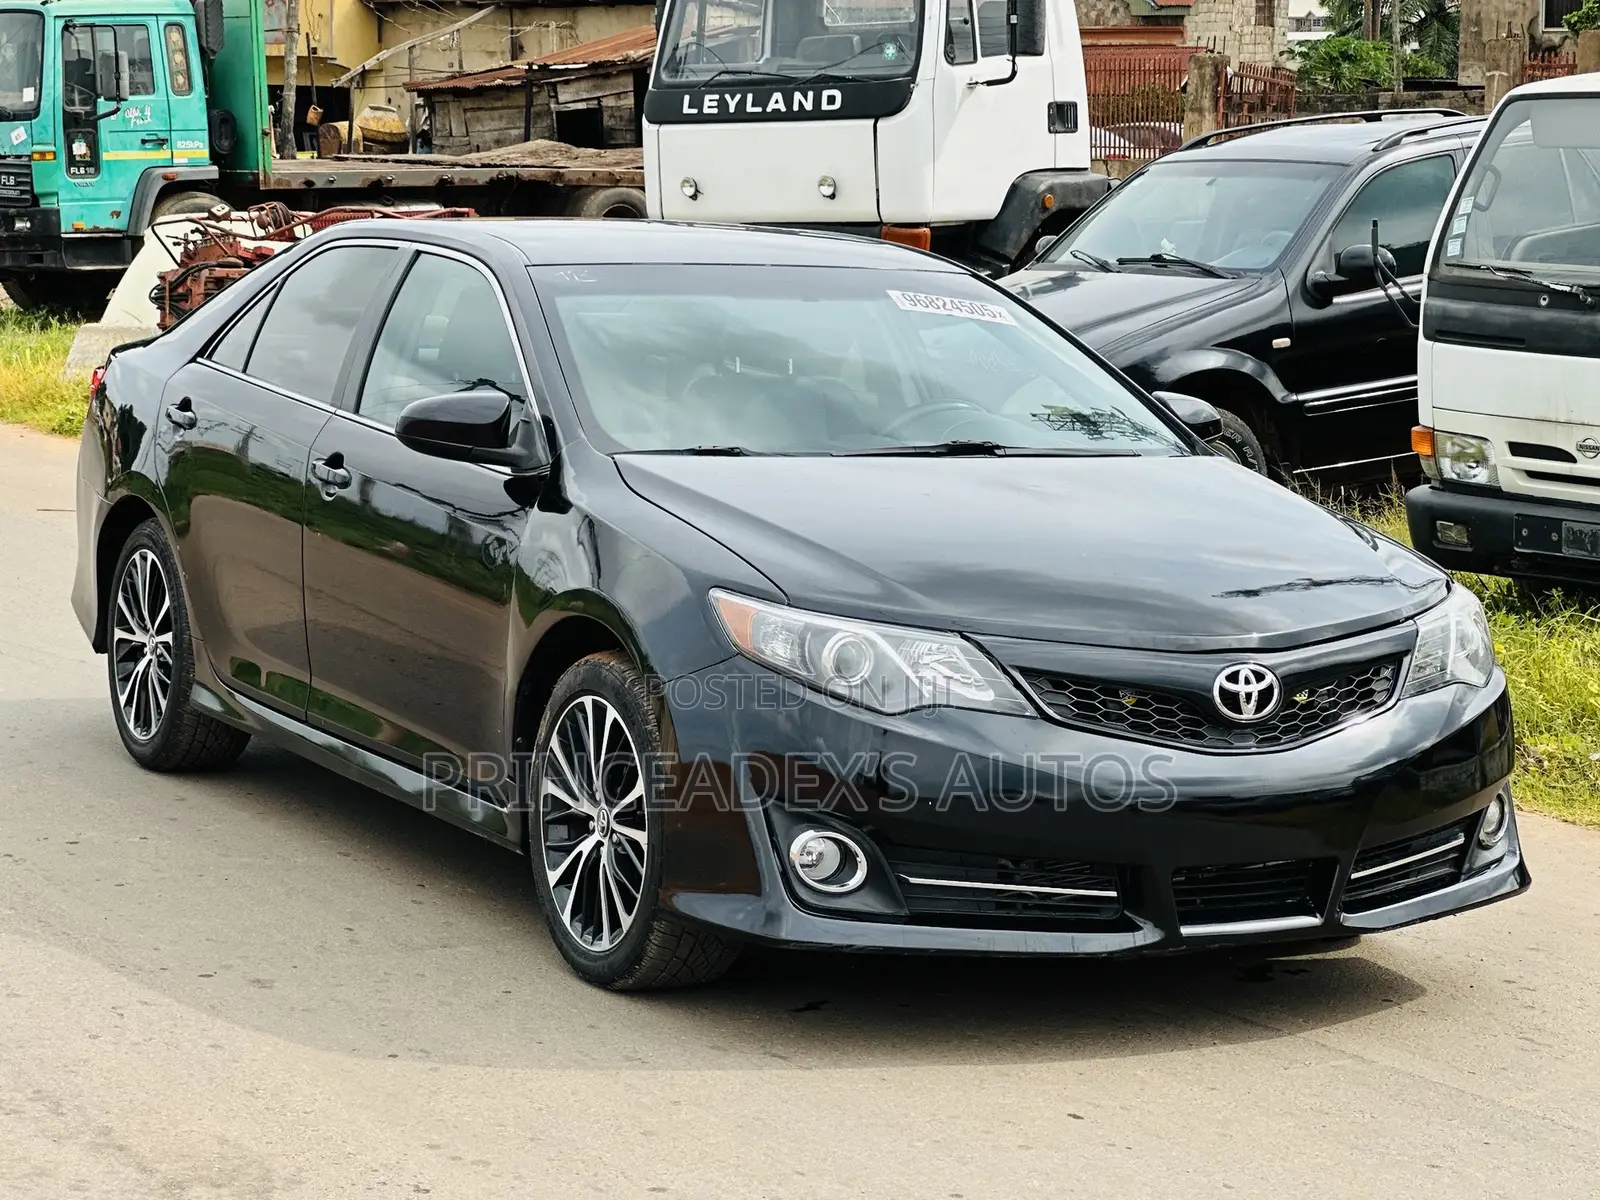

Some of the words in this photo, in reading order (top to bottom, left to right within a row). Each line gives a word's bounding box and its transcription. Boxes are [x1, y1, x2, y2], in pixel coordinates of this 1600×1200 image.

[682, 89, 842, 114] LEYLAND
[176, 141, 204, 149] 825kPa
[1579, 444, 1600, 452] NISSAN
